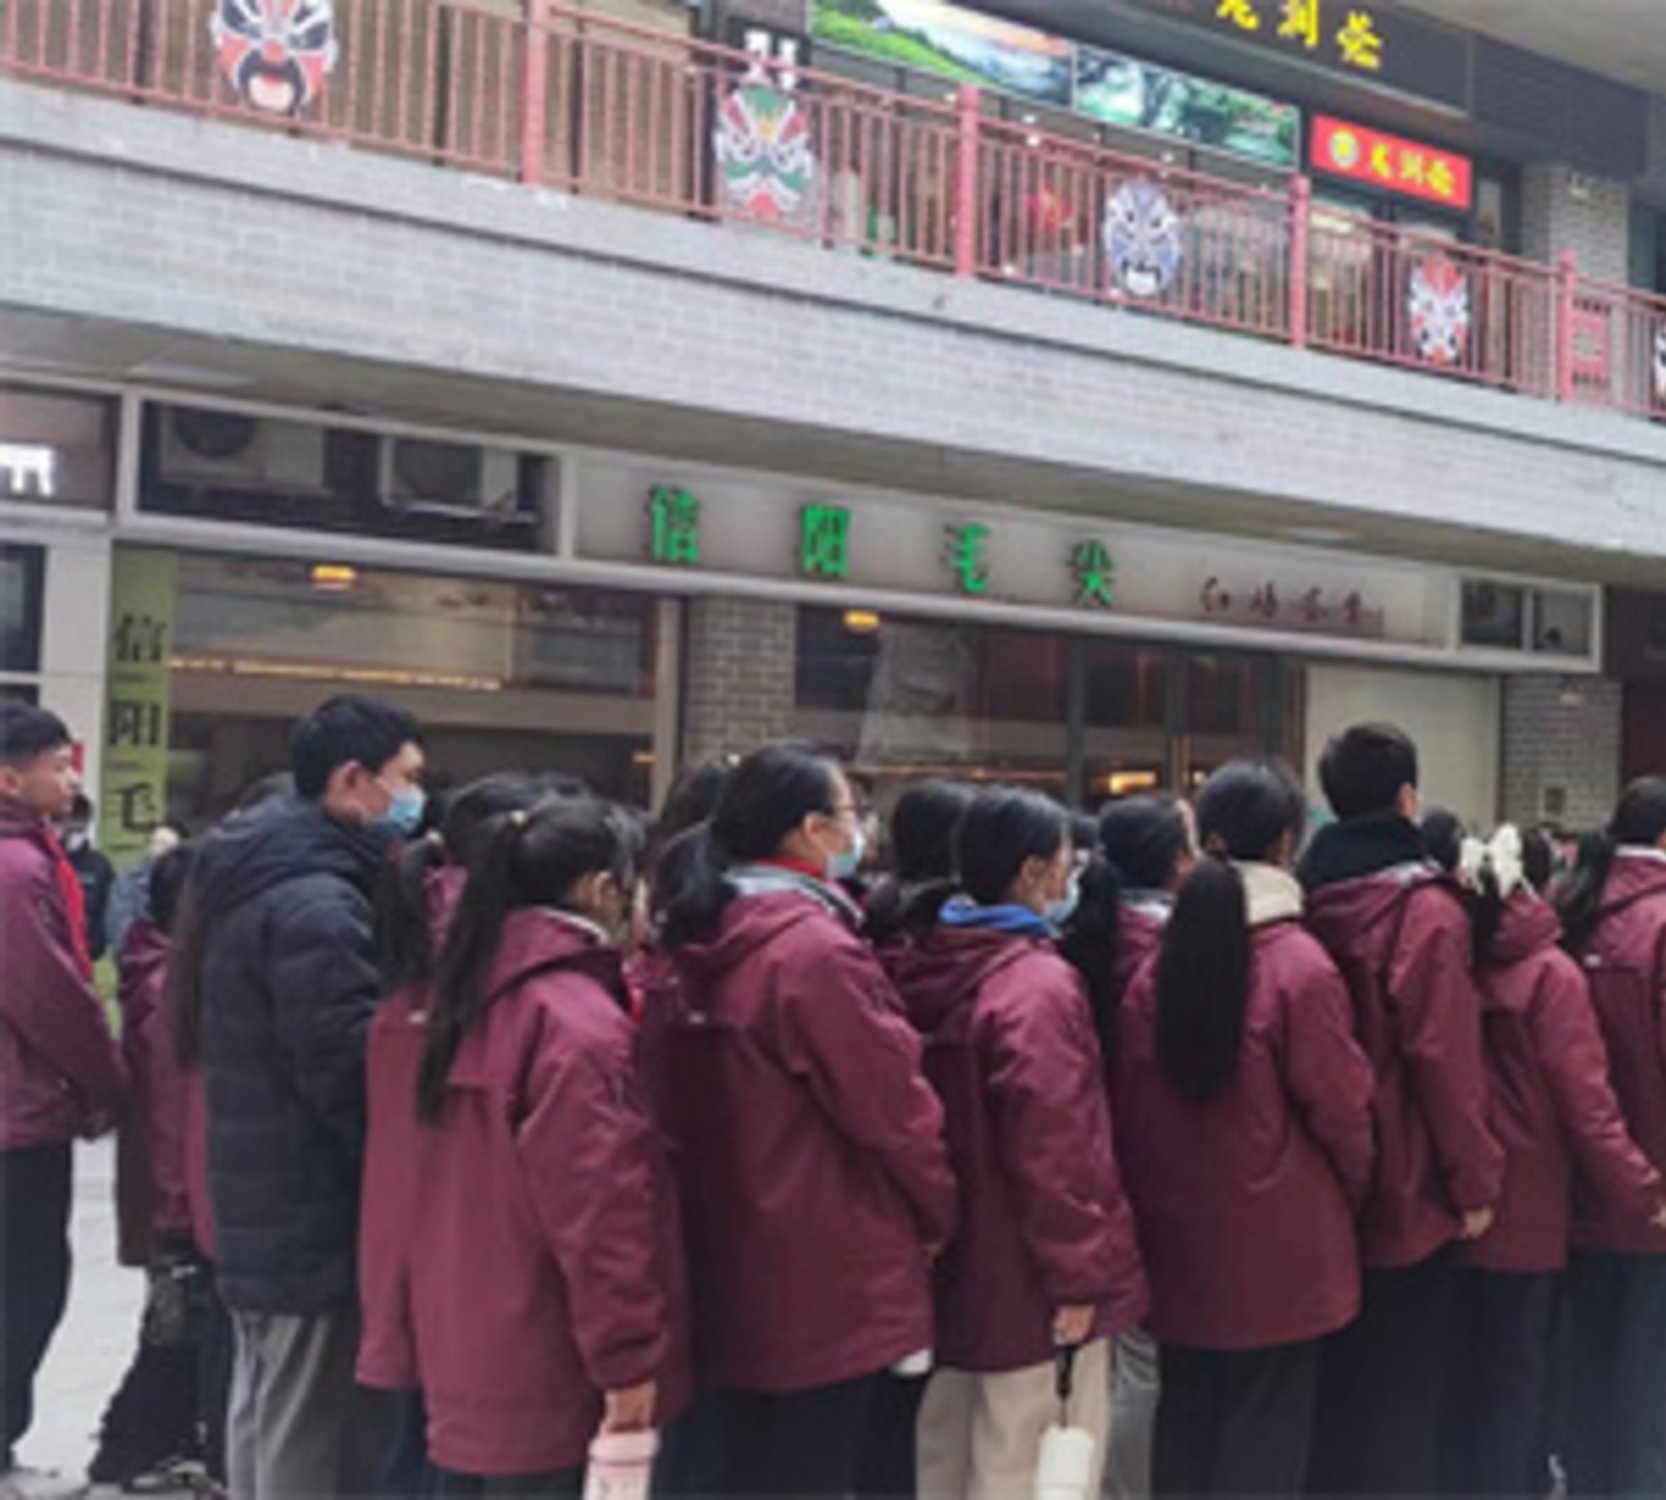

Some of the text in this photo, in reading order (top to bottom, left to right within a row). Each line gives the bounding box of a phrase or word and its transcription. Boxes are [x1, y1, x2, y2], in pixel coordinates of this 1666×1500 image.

[649, 483, 1114, 606] 信阳毛尖
[108, 612, 176, 836] 信阳毛
